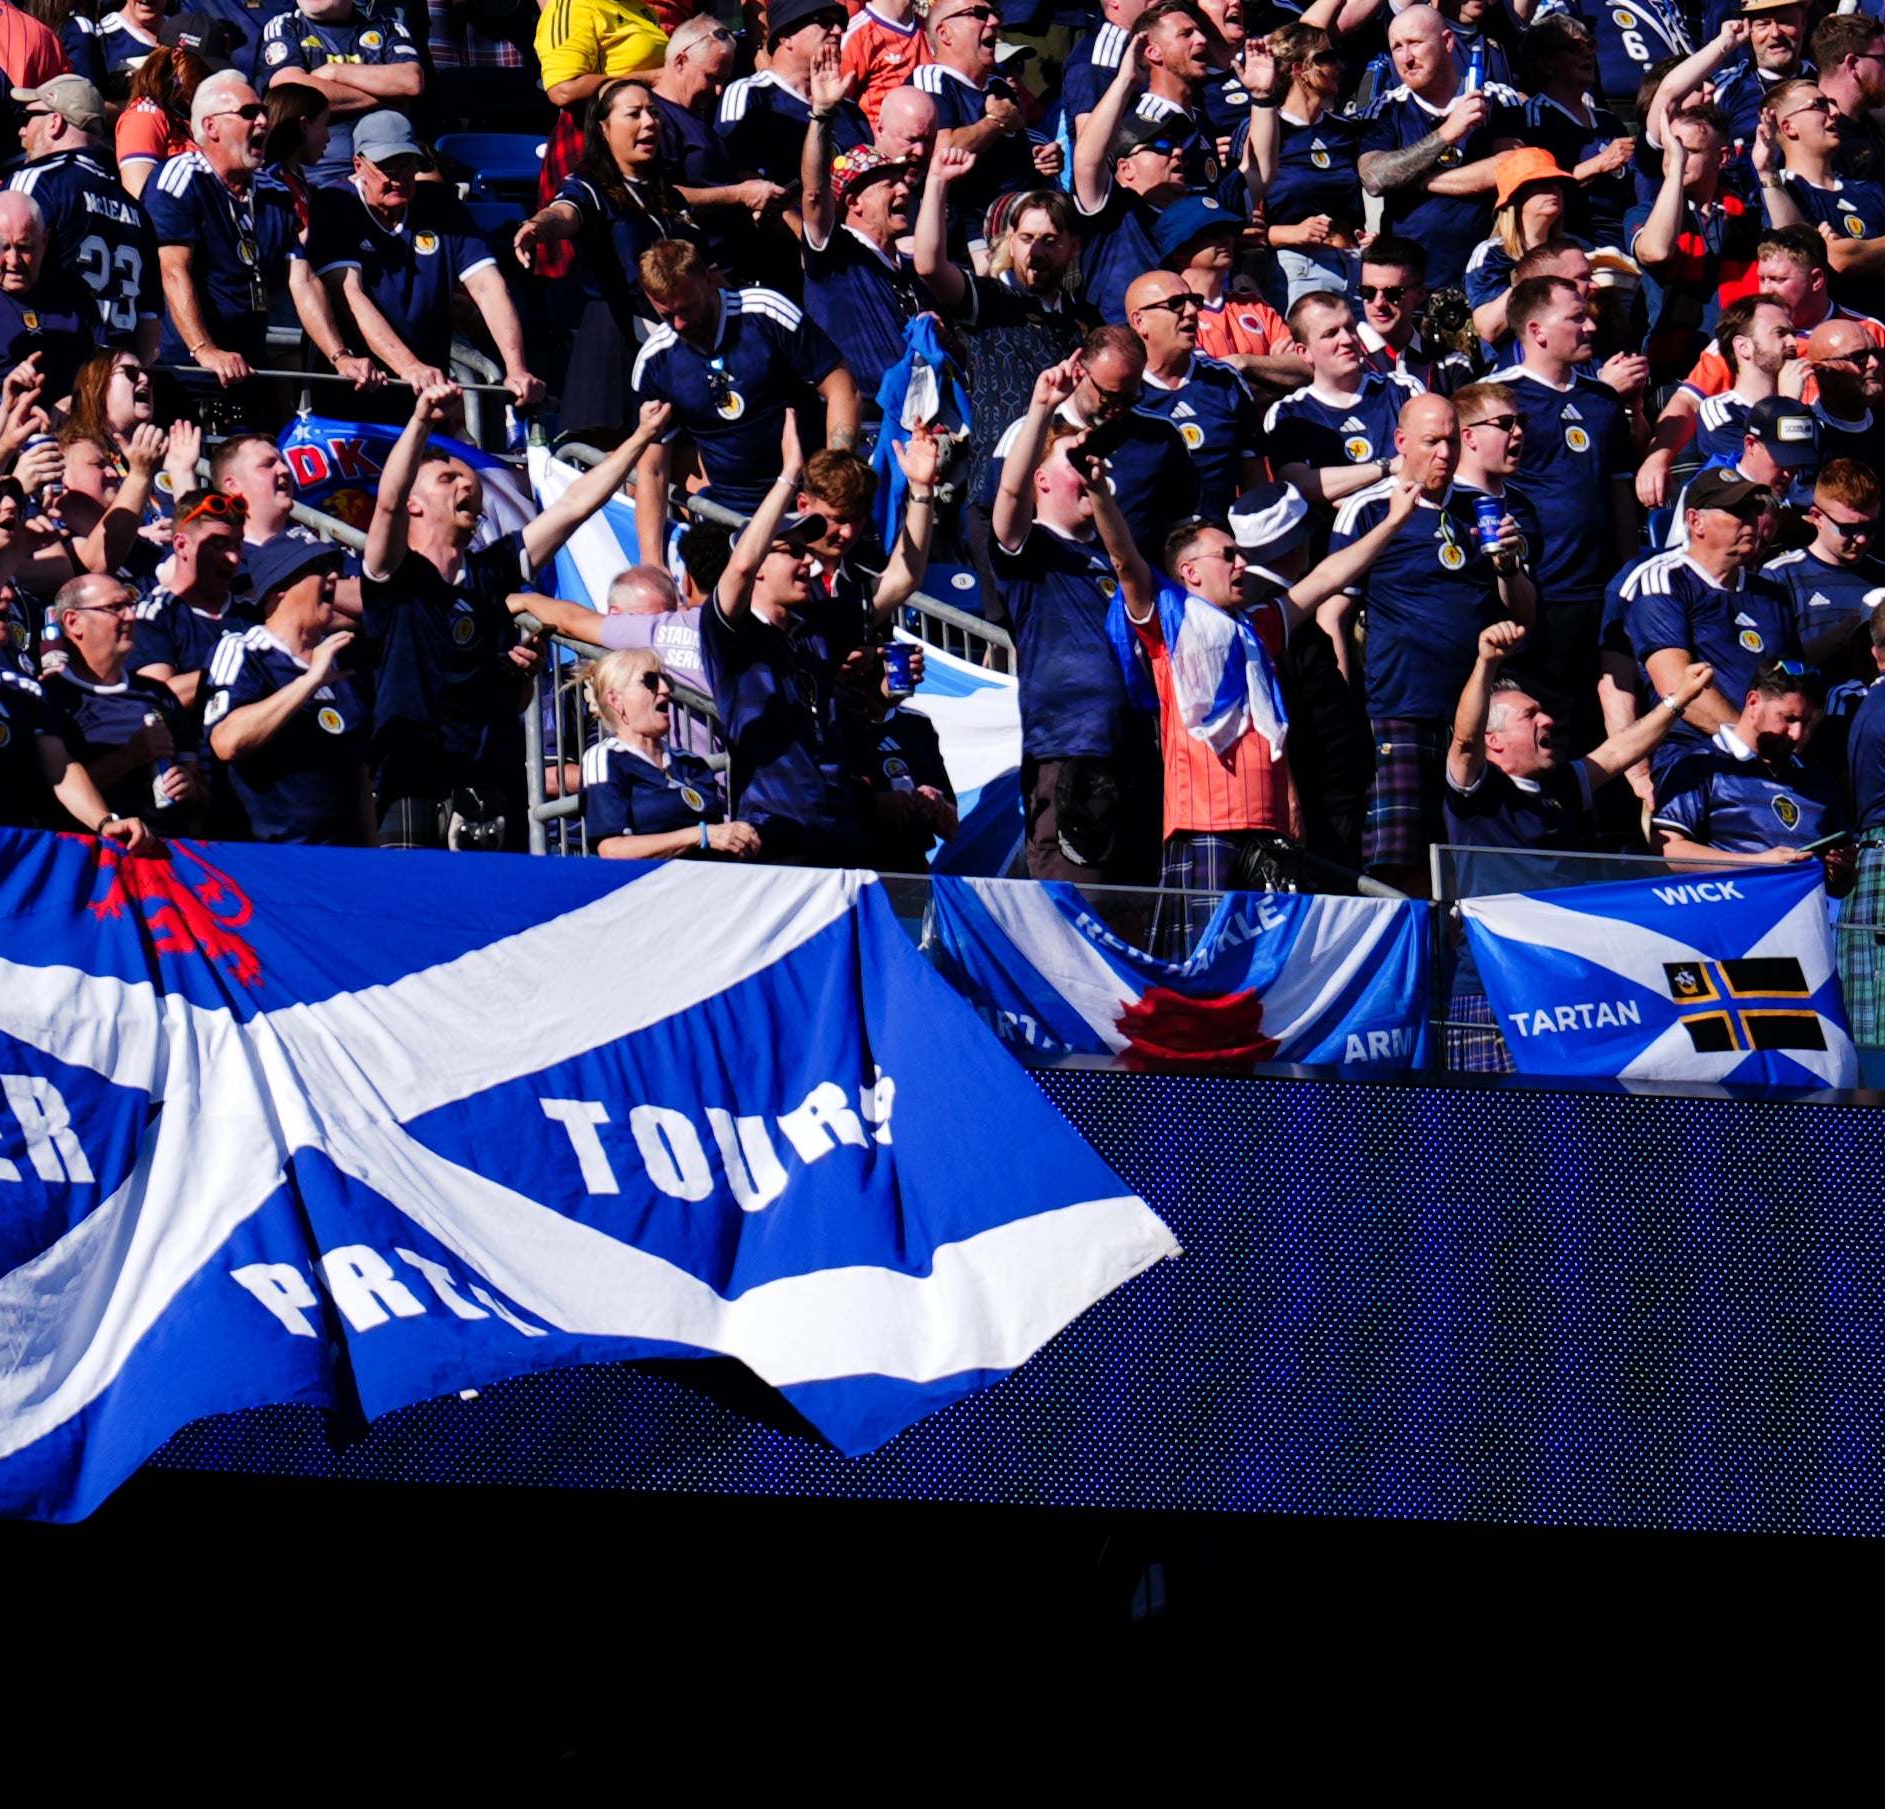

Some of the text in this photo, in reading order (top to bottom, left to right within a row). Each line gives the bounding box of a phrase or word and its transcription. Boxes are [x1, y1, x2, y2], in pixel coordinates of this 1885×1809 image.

[1620, 30, 1651, 61] 6
[657, 624, 702, 647] STADI
[1651, 878, 1746, 906] WICK
[1510, 1000, 1642, 1038] TARTAN
